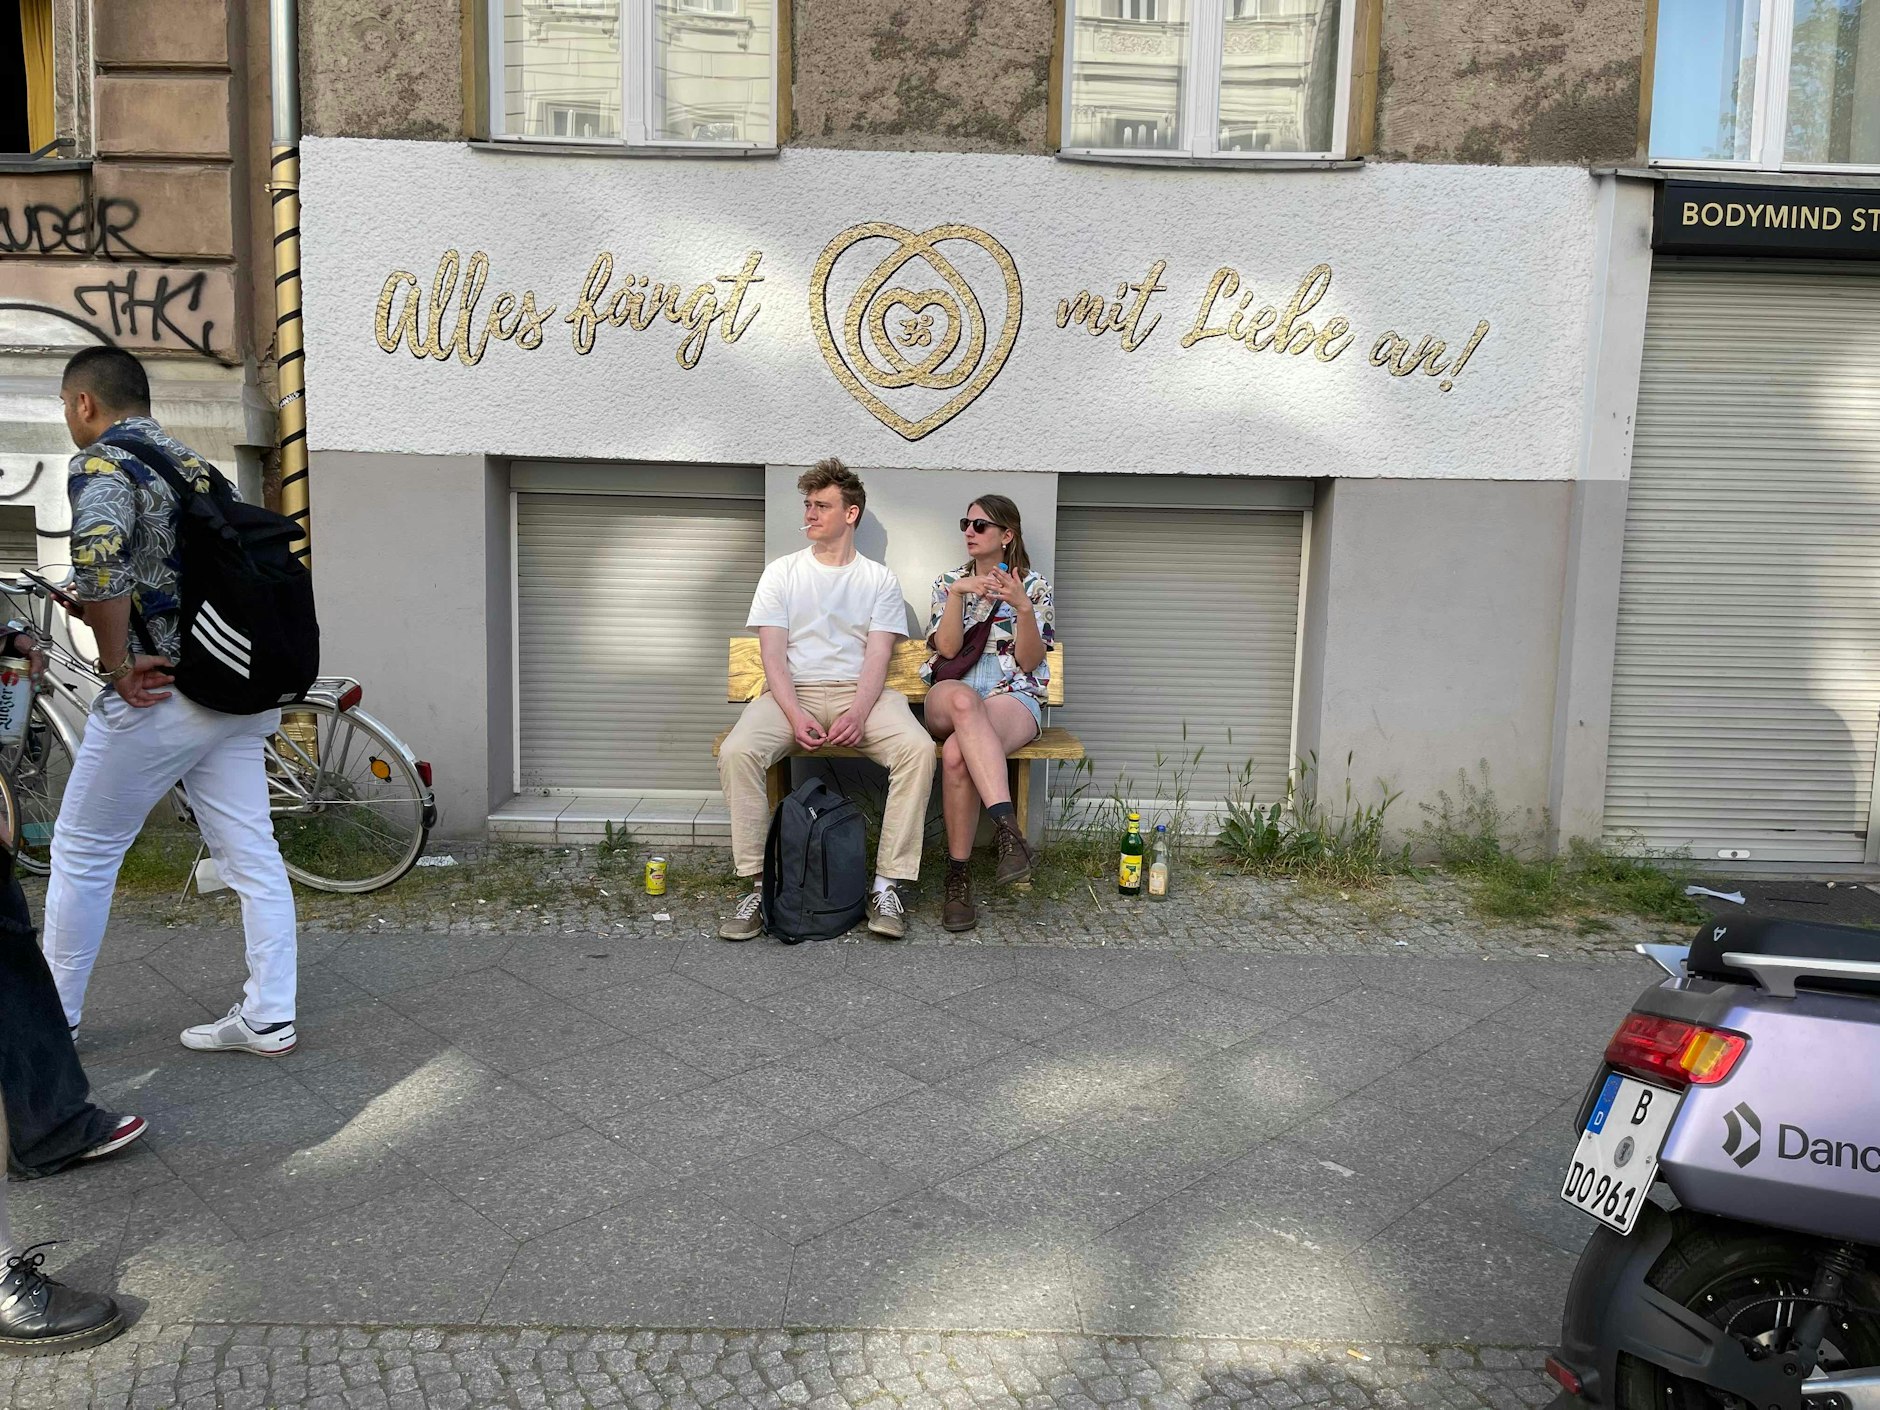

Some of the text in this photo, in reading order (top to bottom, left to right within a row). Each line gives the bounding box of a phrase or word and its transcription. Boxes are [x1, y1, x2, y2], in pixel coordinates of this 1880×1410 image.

[1682, 202, 1842, 231] BODYMIND
[375, 249, 1490, 393] Alles fängt mit Liebe an!
[1593, 1110, 1604, 1126] D
[1630, 1089, 1654, 1126] B
[1777, 1123, 1880, 1173] Danc
